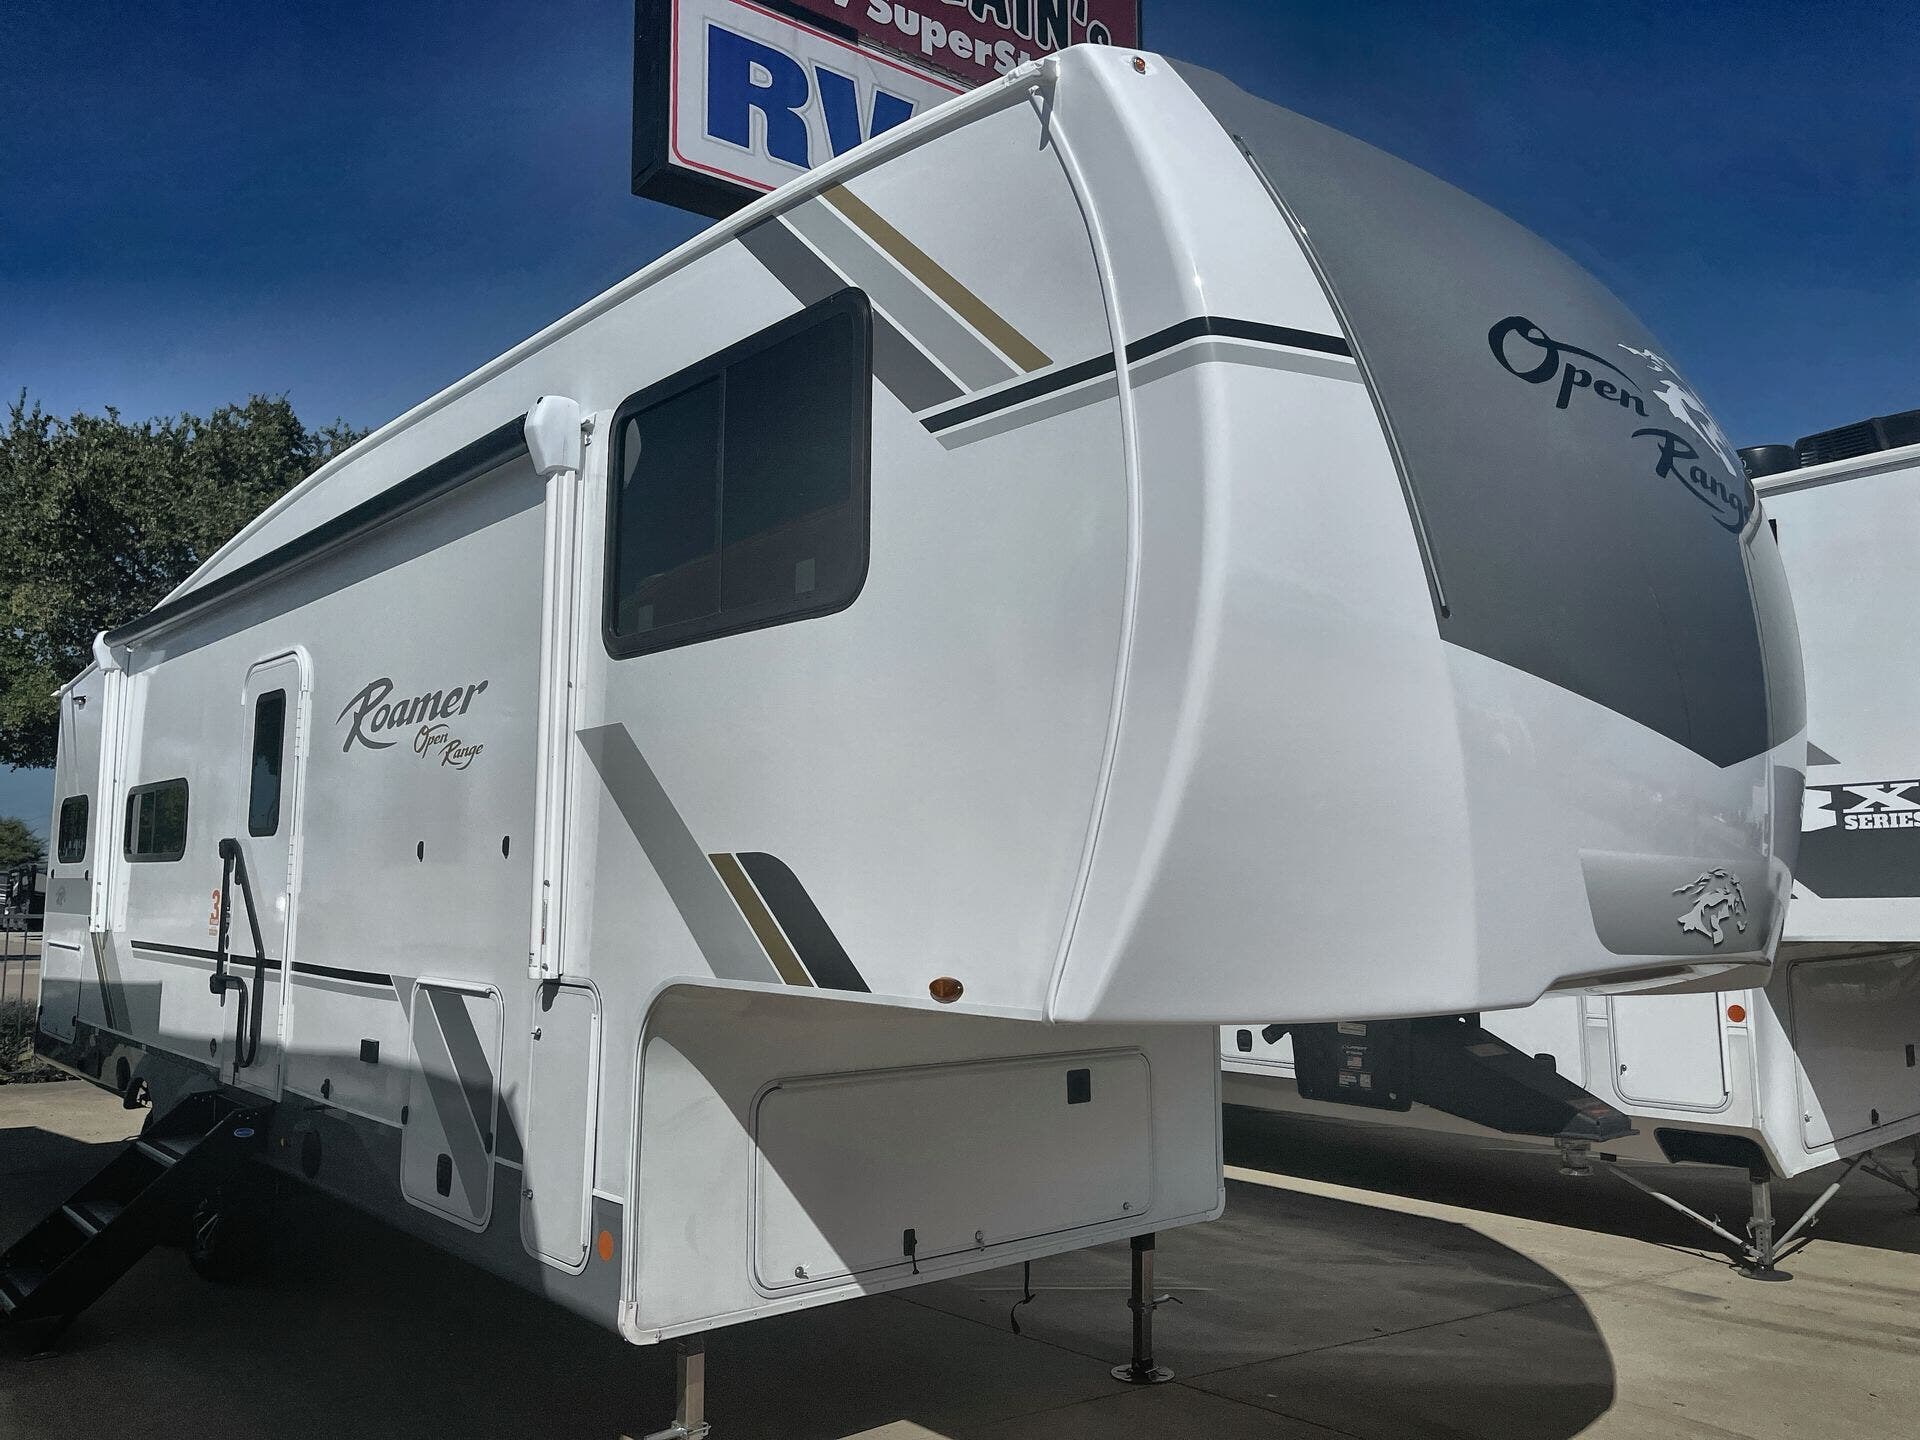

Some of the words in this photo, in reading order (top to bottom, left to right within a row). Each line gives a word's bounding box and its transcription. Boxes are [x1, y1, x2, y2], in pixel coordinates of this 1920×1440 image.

[706, 23, 916, 170] RV
[1488, 315, 1650, 417] Open
[335, 677, 489, 753] Roamer
[413, 723, 450, 759] Open
[437, 739, 484, 770] Range
